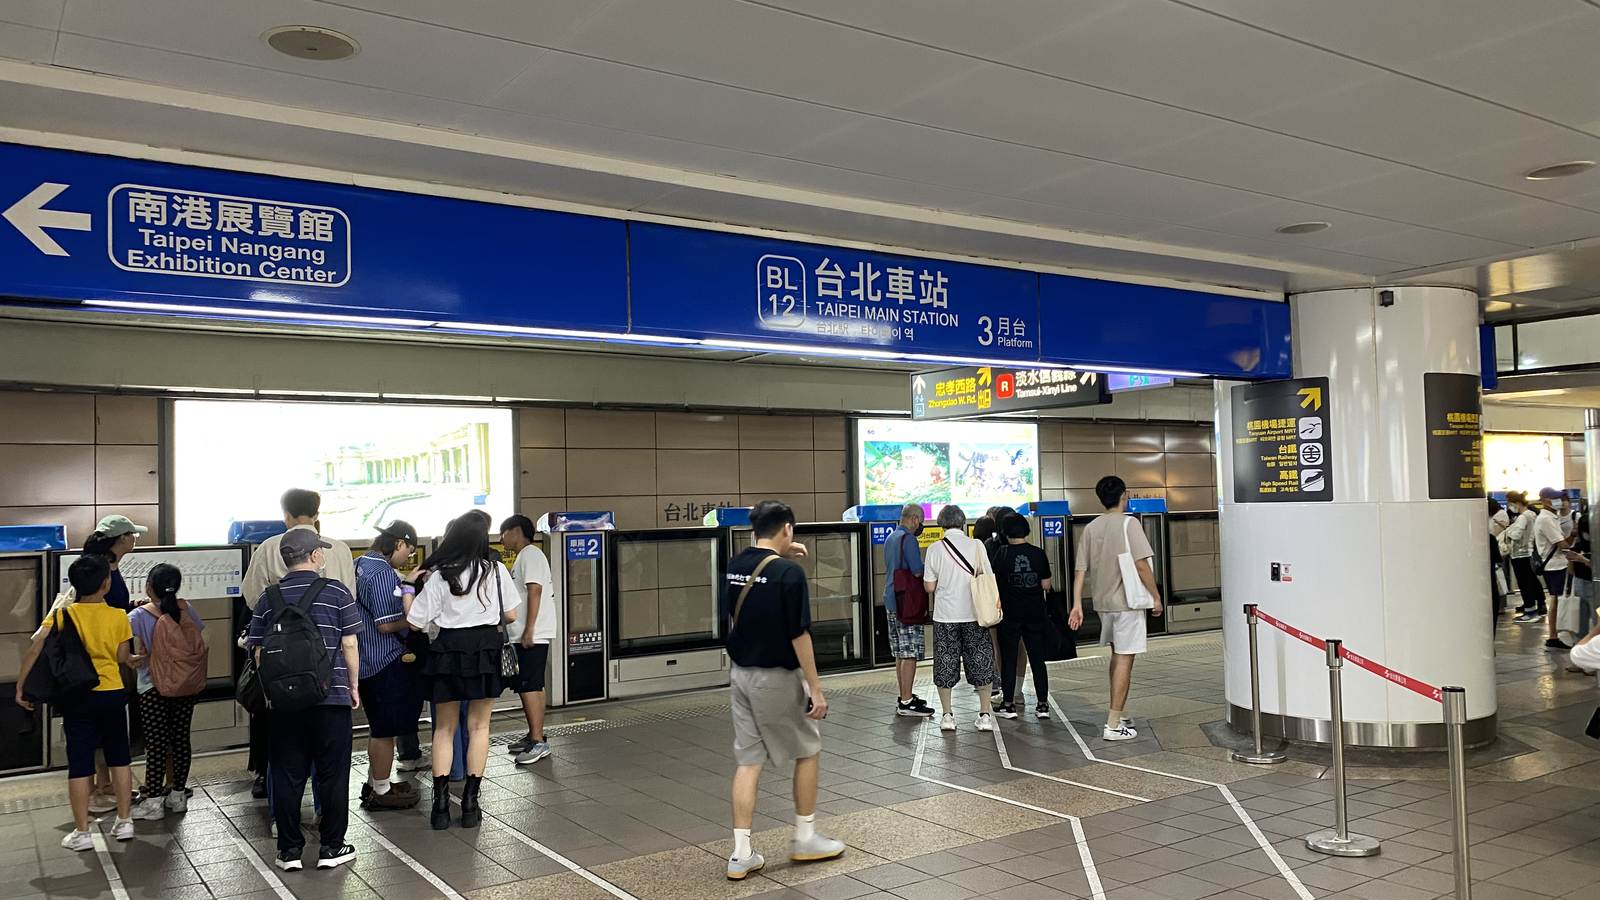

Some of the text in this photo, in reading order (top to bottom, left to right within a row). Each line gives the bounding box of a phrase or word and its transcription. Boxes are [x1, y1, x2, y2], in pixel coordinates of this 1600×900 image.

[128, 191, 334, 243] 南港展覽館
[138, 228, 326, 265] Taipei Nangang
[128, 250, 337, 283] Exhibition Center
[766, 266, 798, 291] BL
[815, 257, 949, 309] 台北車站
[768, 294, 796, 320] 12
[815, 301, 959, 327] TAIPEI MAIN STATION
[904, 327, 914, 341] 역
[977, 315, 994, 346] 3
[997, 316, 1026, 337] 月台
[997, 337, 1033, 349] Platform
[935, 376, 977, 397] 忠孝西路
[1001, 381, 1009, 392] R
[1061, 384, 1078, 393] Line
[664, 501, 733, 522] 台北車
[1055, 521, 1062, 534] 2
[587, 538, 599, 556] 2
